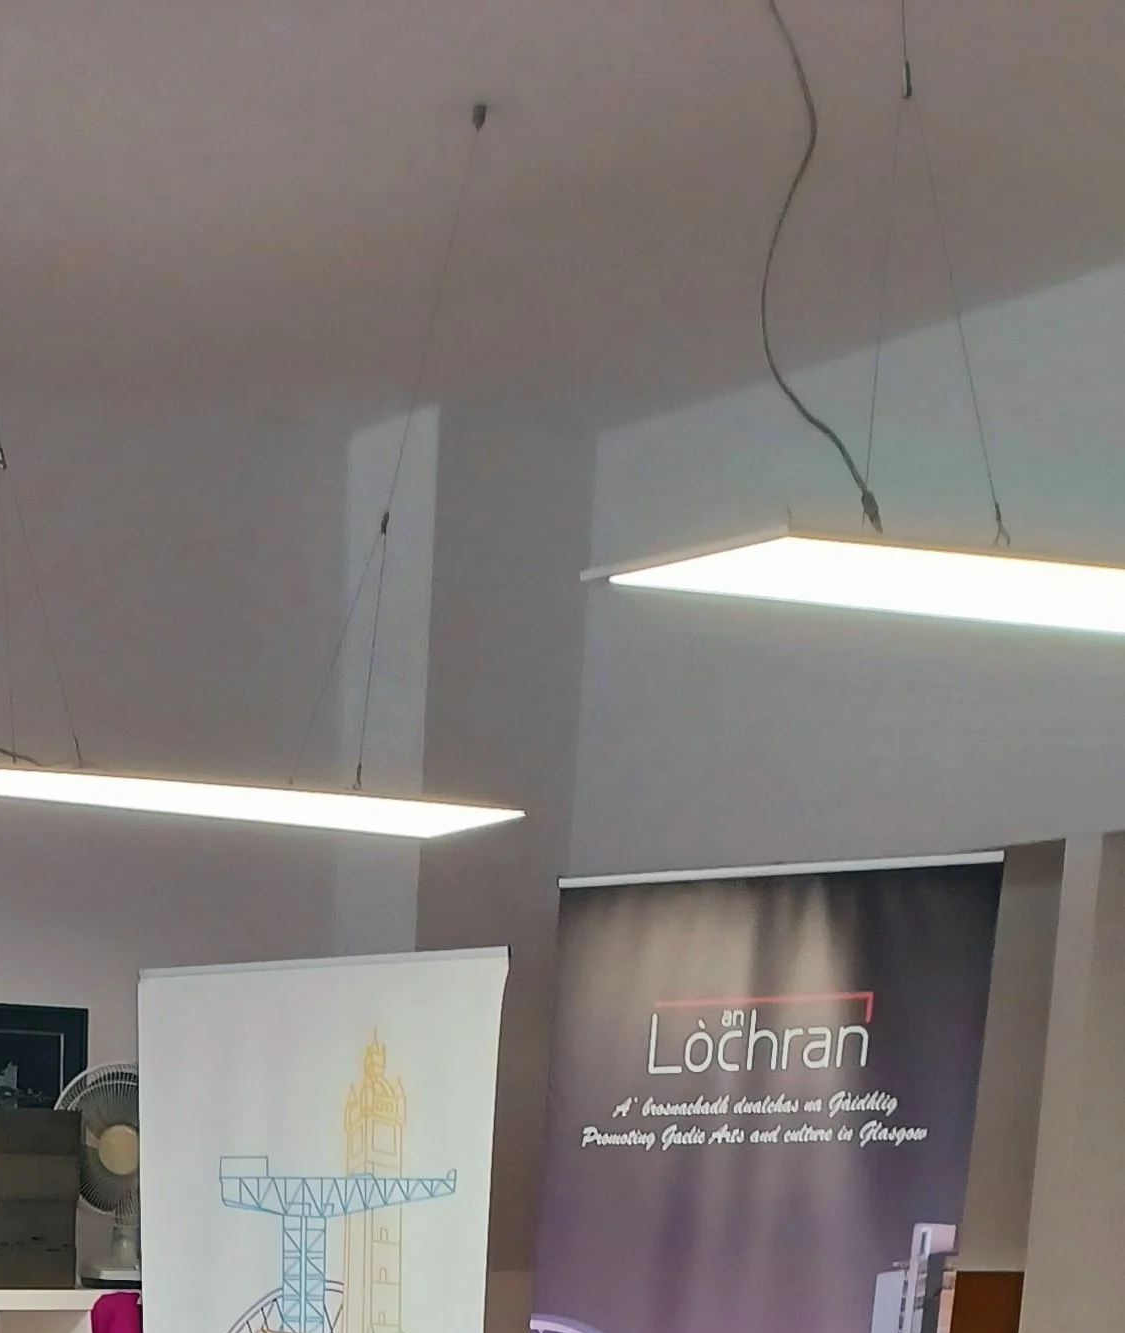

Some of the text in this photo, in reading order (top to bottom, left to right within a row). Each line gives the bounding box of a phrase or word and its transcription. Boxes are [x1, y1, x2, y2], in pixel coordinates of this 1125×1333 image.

[722, 1008, 744, 1027] an
[648, 1008, 870, 1075] Lòchran
[642, 1094, 730, 1117] brosnachadh
[733, 1092, 799, 1115] dualchas
[803, 1098, 823, 1113] na
[581, 1119, 928, 1151] Promoting Gaelic Arts and culture in Glasgow
